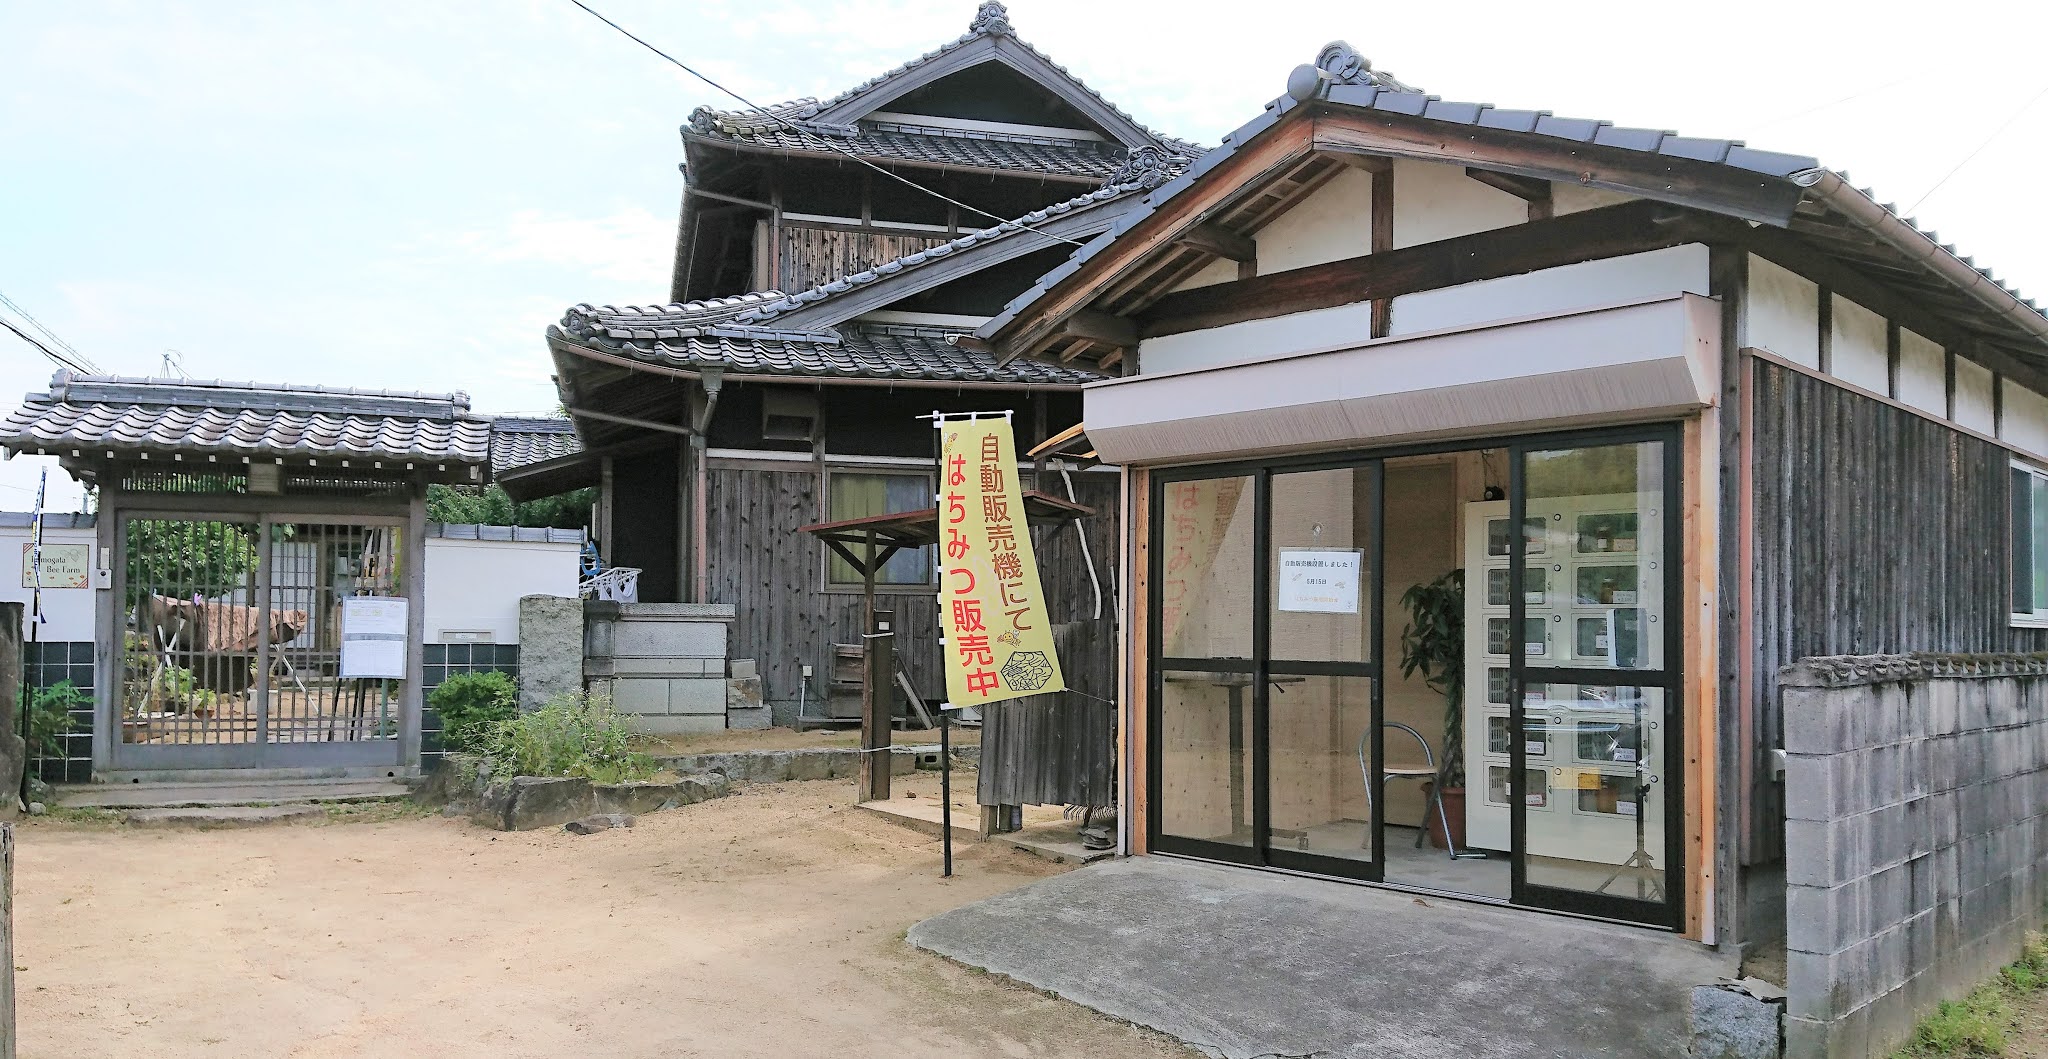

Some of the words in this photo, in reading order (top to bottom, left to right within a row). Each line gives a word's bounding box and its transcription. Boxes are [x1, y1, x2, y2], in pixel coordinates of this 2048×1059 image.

[46, 565, 60, 573] Bee
[947, 454, 1000, 697] はちみつ販売中
[980, 433, 1032, 631] 自動販売機にて
